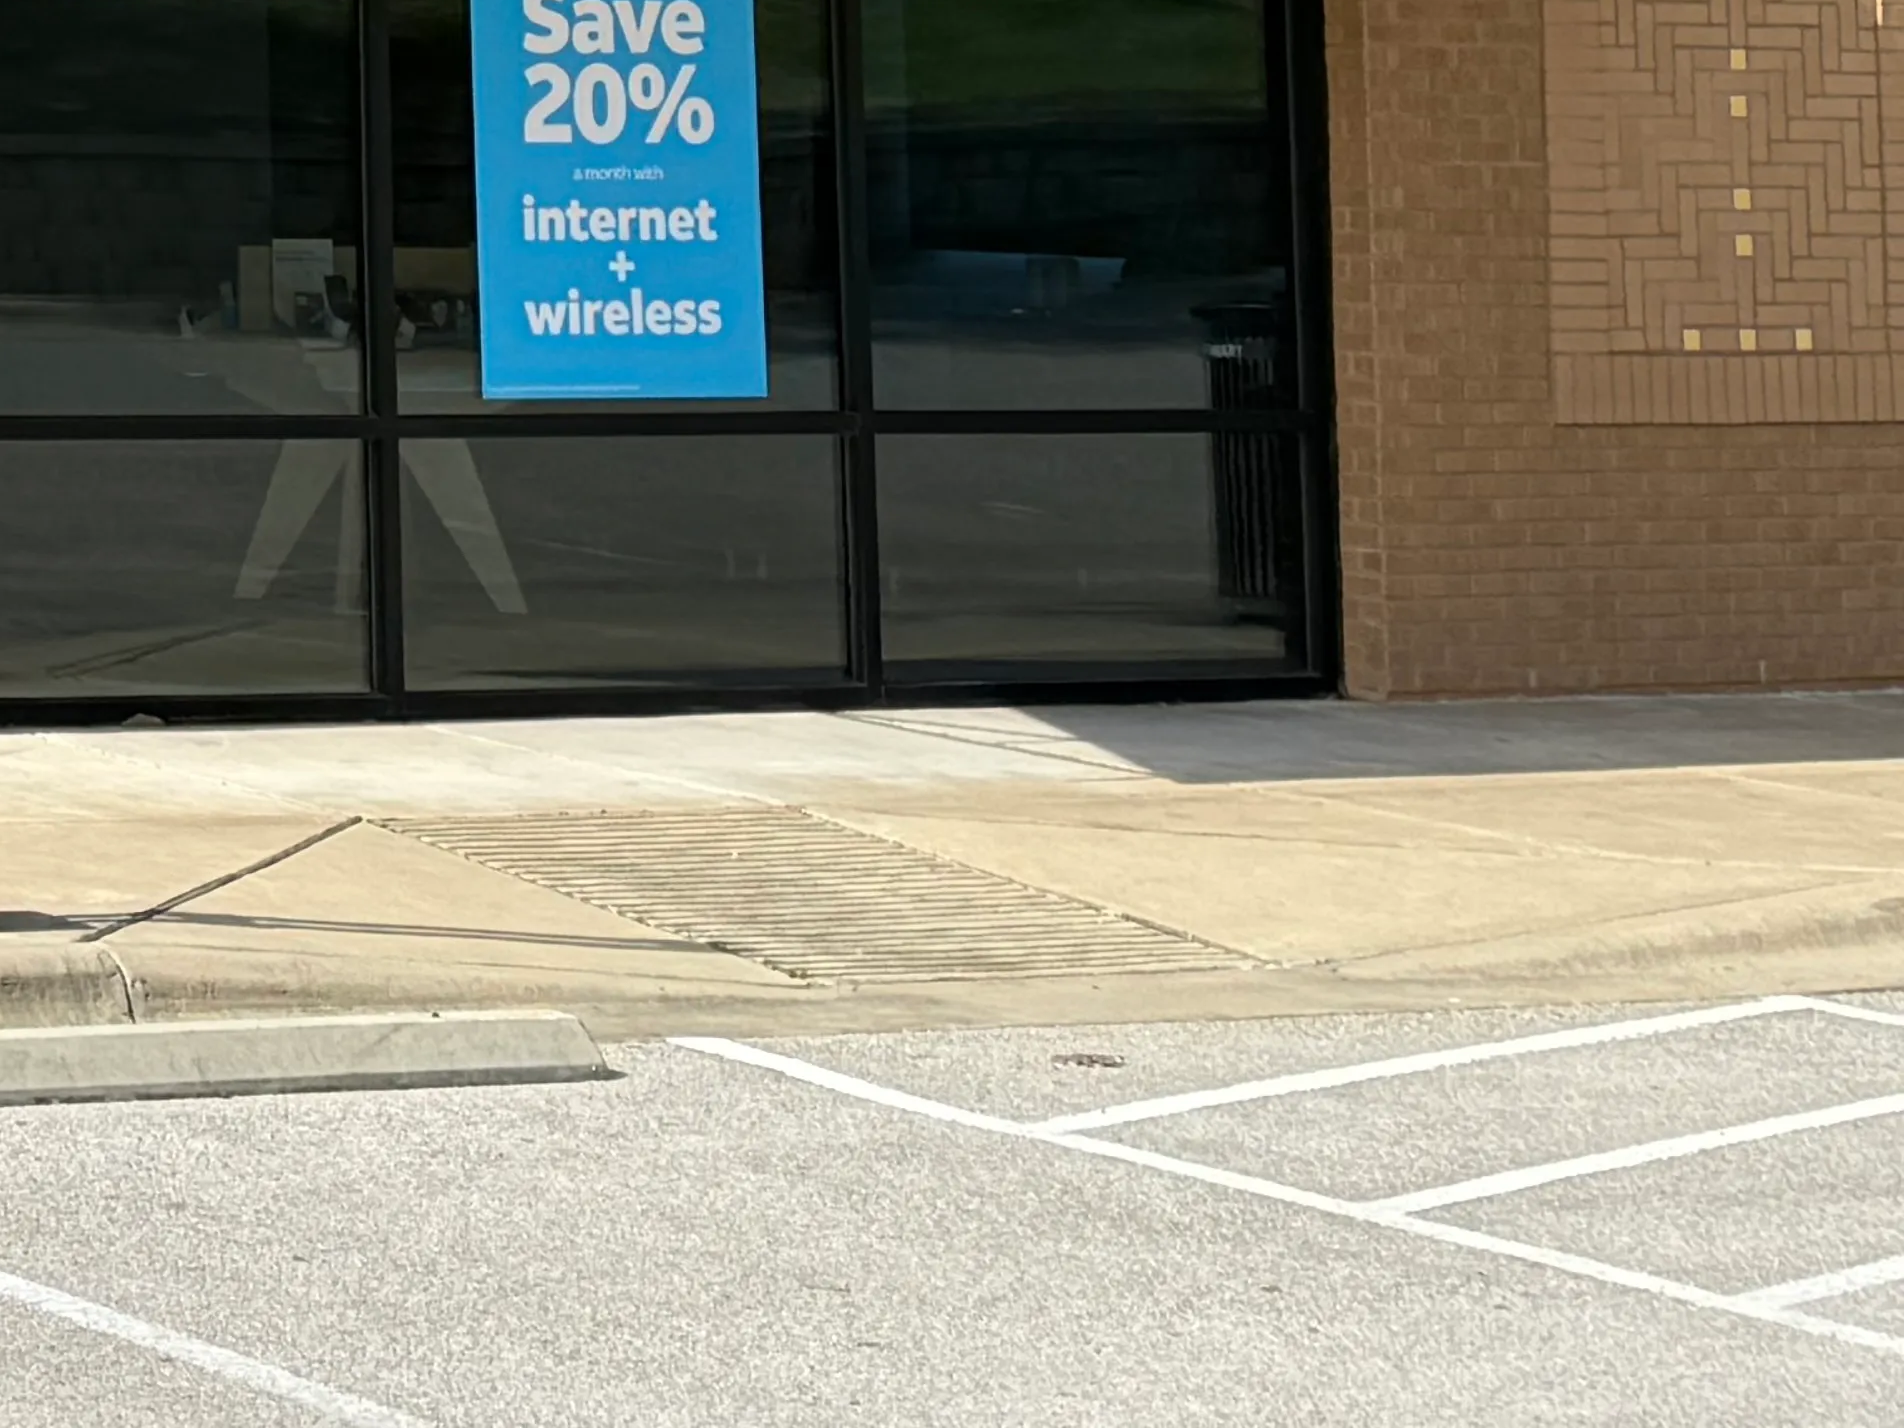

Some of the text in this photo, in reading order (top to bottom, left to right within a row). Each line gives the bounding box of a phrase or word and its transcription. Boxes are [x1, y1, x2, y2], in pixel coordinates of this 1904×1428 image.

[524, 62, 715, 145] 20%
[573, 165, 664, 181] a month with
[523, 194, 718, 242] internet
[608, 250, 636, 282] +
[524, 287, 722, 335] wireless
